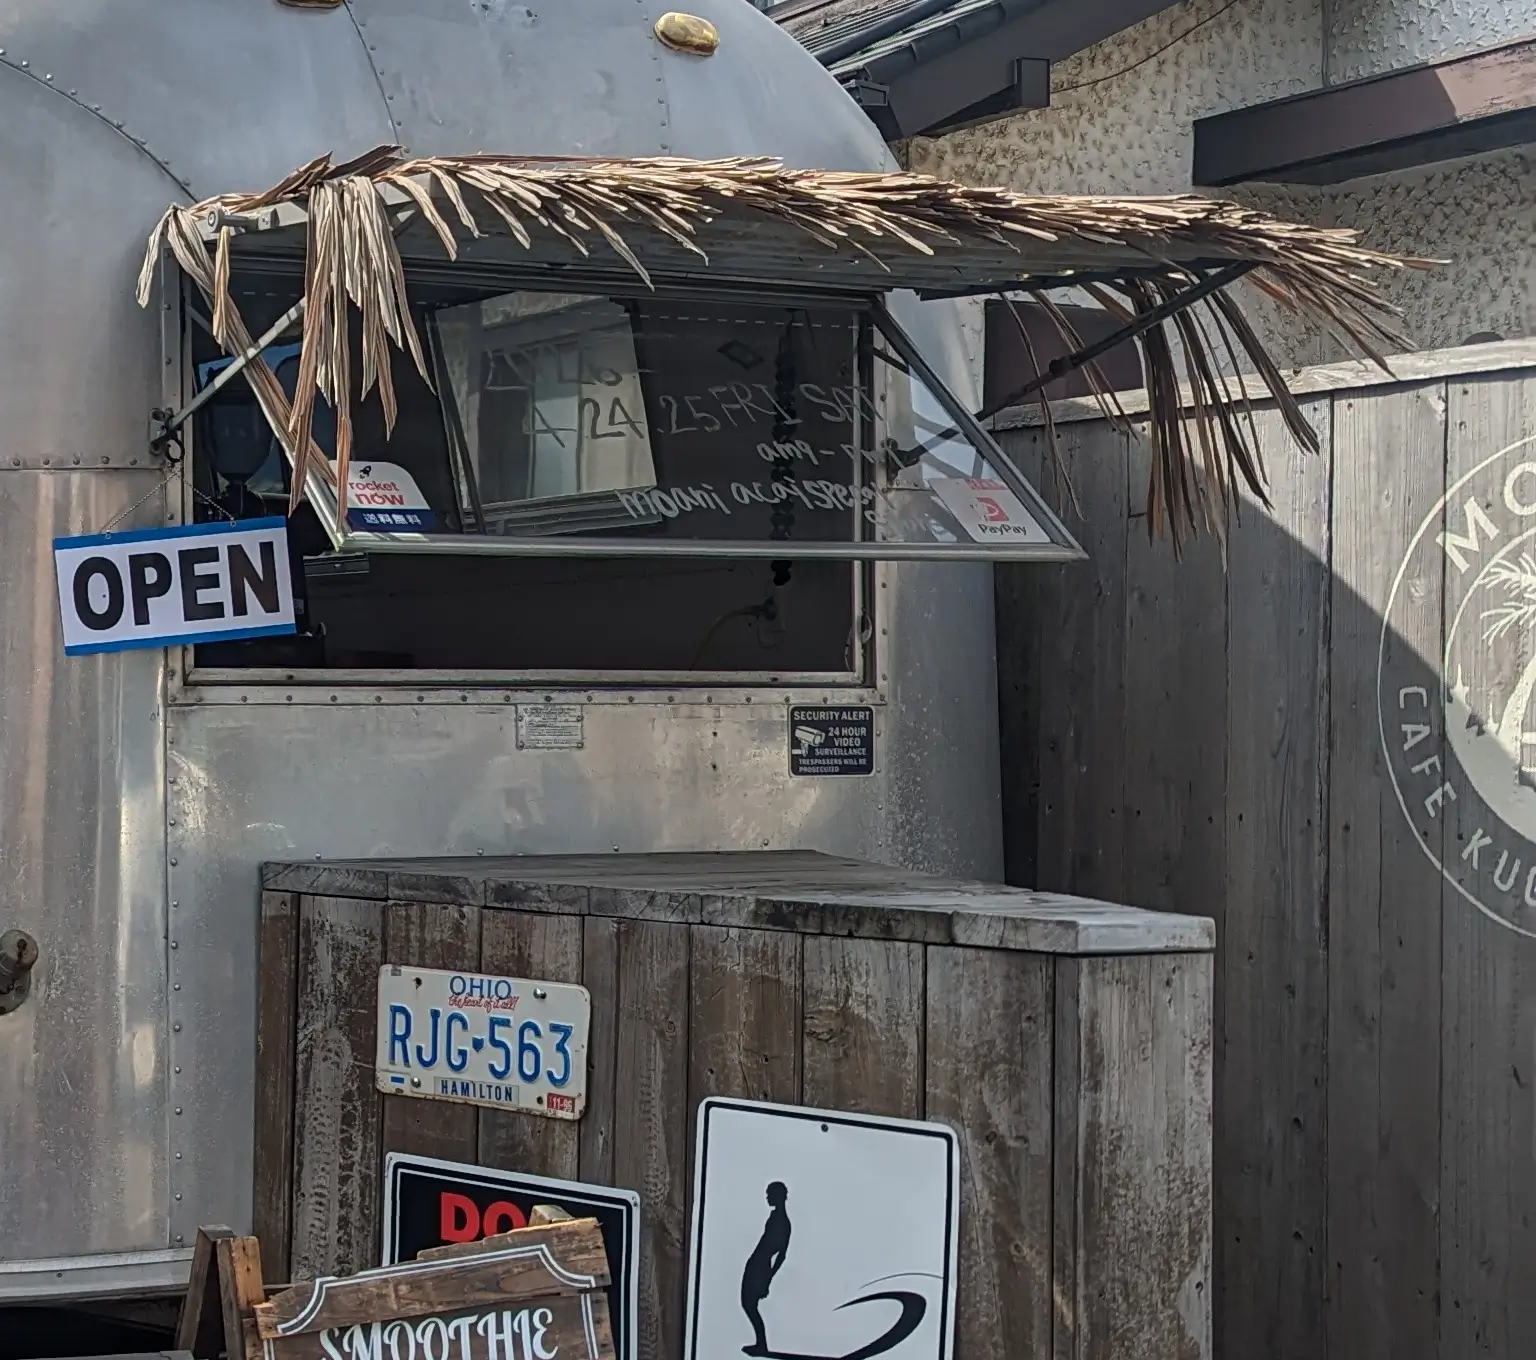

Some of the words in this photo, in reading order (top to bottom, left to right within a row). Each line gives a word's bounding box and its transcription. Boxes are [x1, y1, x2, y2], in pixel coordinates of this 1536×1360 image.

[347, 480, 400, 492] rocket
[355, 492, 405, 506] now
[977, 523, 1027, 536] PayPay
[71, 540, 282, 632] OPEN
[793, 710, 840, 721] SECURITY
[840, 710, 870, 721] ALERT
[827, 726, 840, 737] 24
[841, 726, 867, 737] HOUR
[833, 737, 861, 747] VIDEO
[814, 747, 867, 756] SURVEILLANCE
[1398, 684, 1457, 820] CAFE
[448, 975, 512, 1001] OHIO
[440, 1079, 514, 1103] HAMILTON
